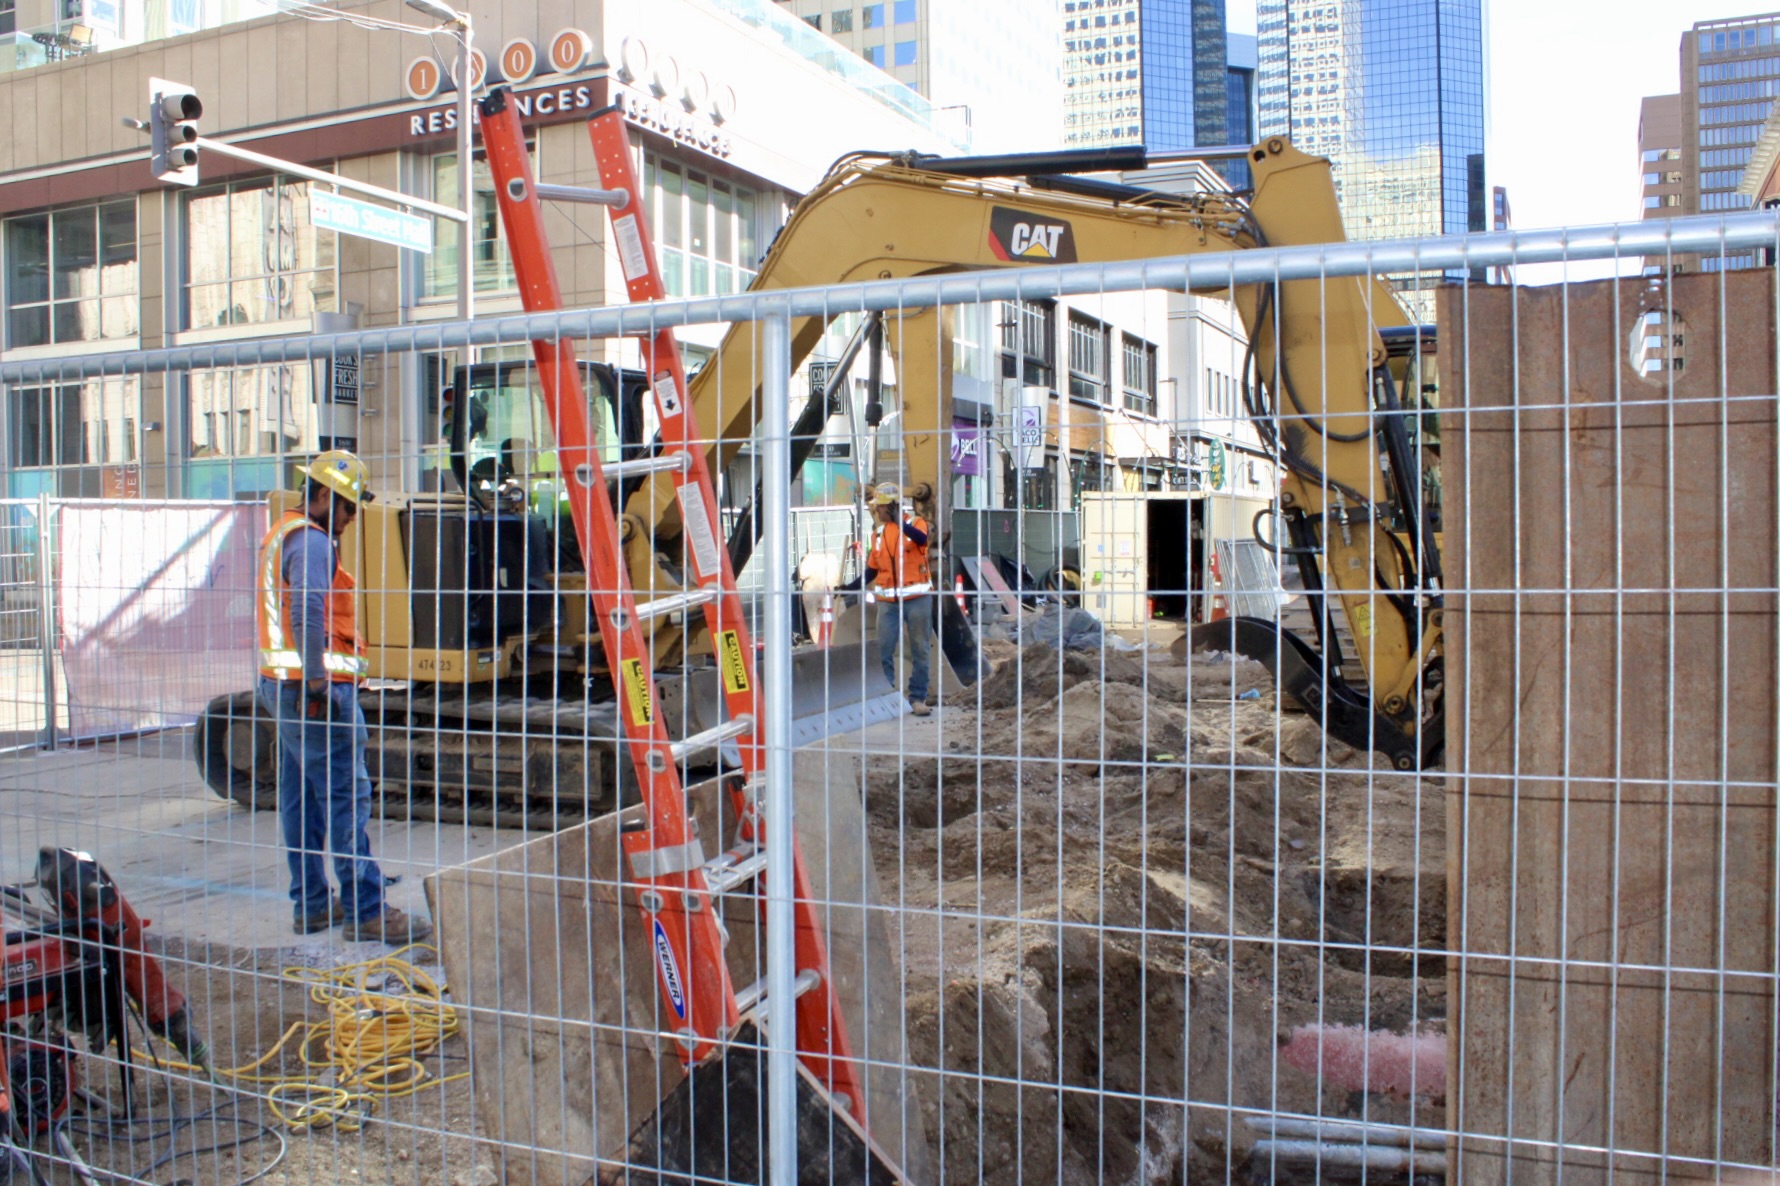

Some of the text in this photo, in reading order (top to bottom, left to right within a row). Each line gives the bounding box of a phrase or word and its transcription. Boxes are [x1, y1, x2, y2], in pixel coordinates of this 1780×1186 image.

[411, 86, 590, 136] RESNCES
[1011, 222, 1064, 259] CAT
[333, 388, 359, 398] ARKET
[418, 659, 451, 671] 47423
[729, 636, 745, 686] CAUTION
[659, 942, 679, 998] WERNER
